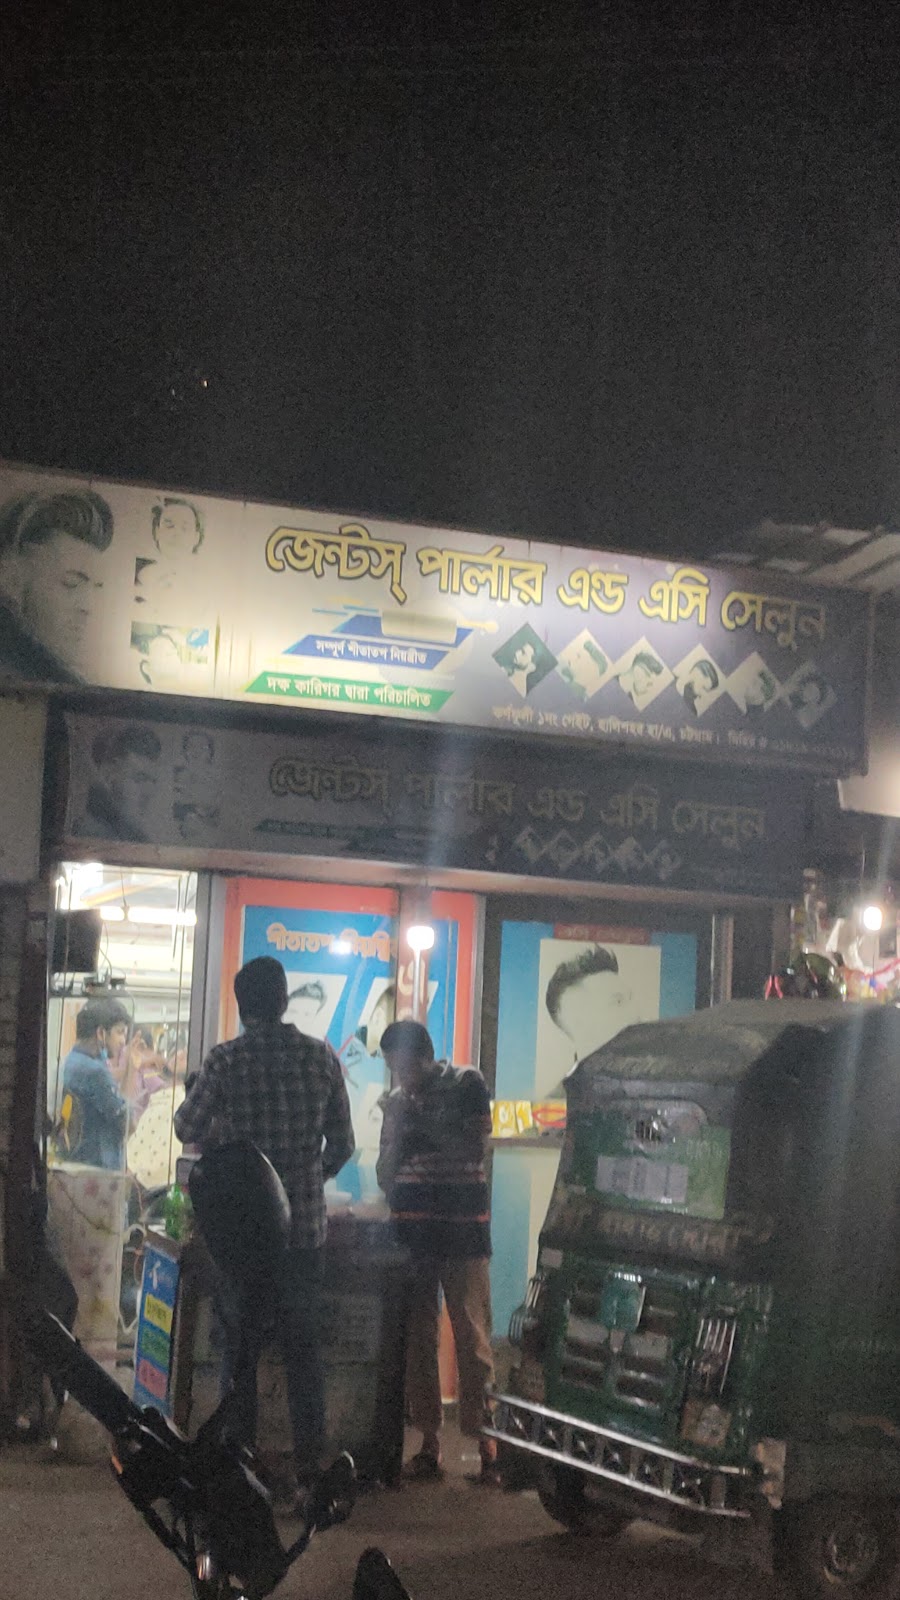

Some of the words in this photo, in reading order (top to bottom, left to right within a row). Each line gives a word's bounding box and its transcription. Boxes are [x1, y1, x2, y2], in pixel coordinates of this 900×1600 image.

[416, 545, 546, 606] পার্লার
[557, 568, 629, 614] এন্ড
[638, 566, 711, 627] এসি
[720, 591, 826, 651] সেলুন
[315, 639, 346, 658] সম্পূর্ণ
[347, 640, 388, 661] শীতাতপ
[266, 676, 292, 693] দক্ষ
[294, 677, 342, 698] কারিগর
[344, 685, 370, 702] দ্বারা
[373, 684, 433, 708] পরিচালিত
[266, 922, 336, 955] শীতাতপ
